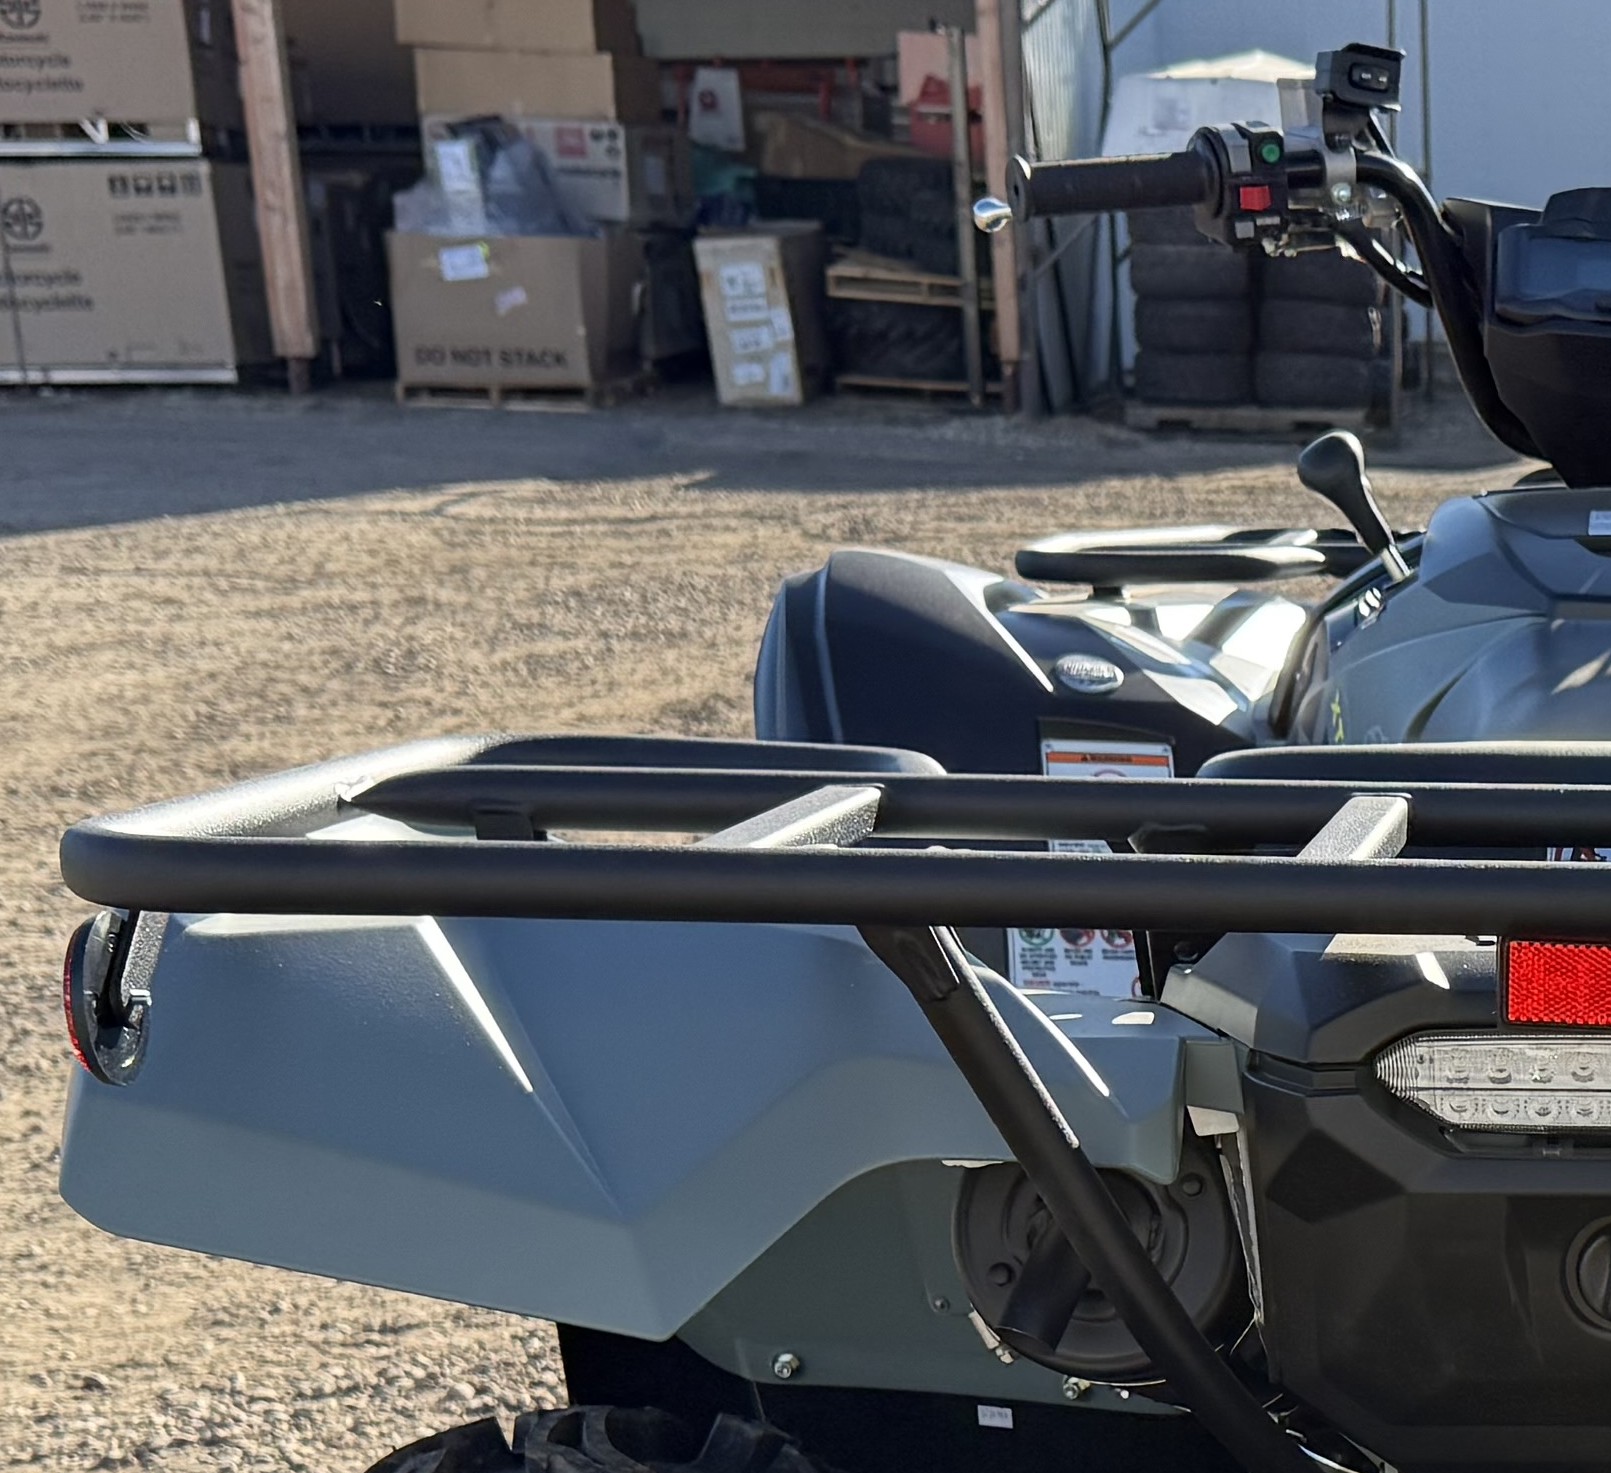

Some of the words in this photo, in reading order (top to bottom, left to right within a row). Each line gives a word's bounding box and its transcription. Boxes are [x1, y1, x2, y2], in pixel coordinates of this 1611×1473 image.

[415, 344, 447, 367] DO
[450, 345, 492, 368] NOT
[499, 346, 569, 369] STACK
